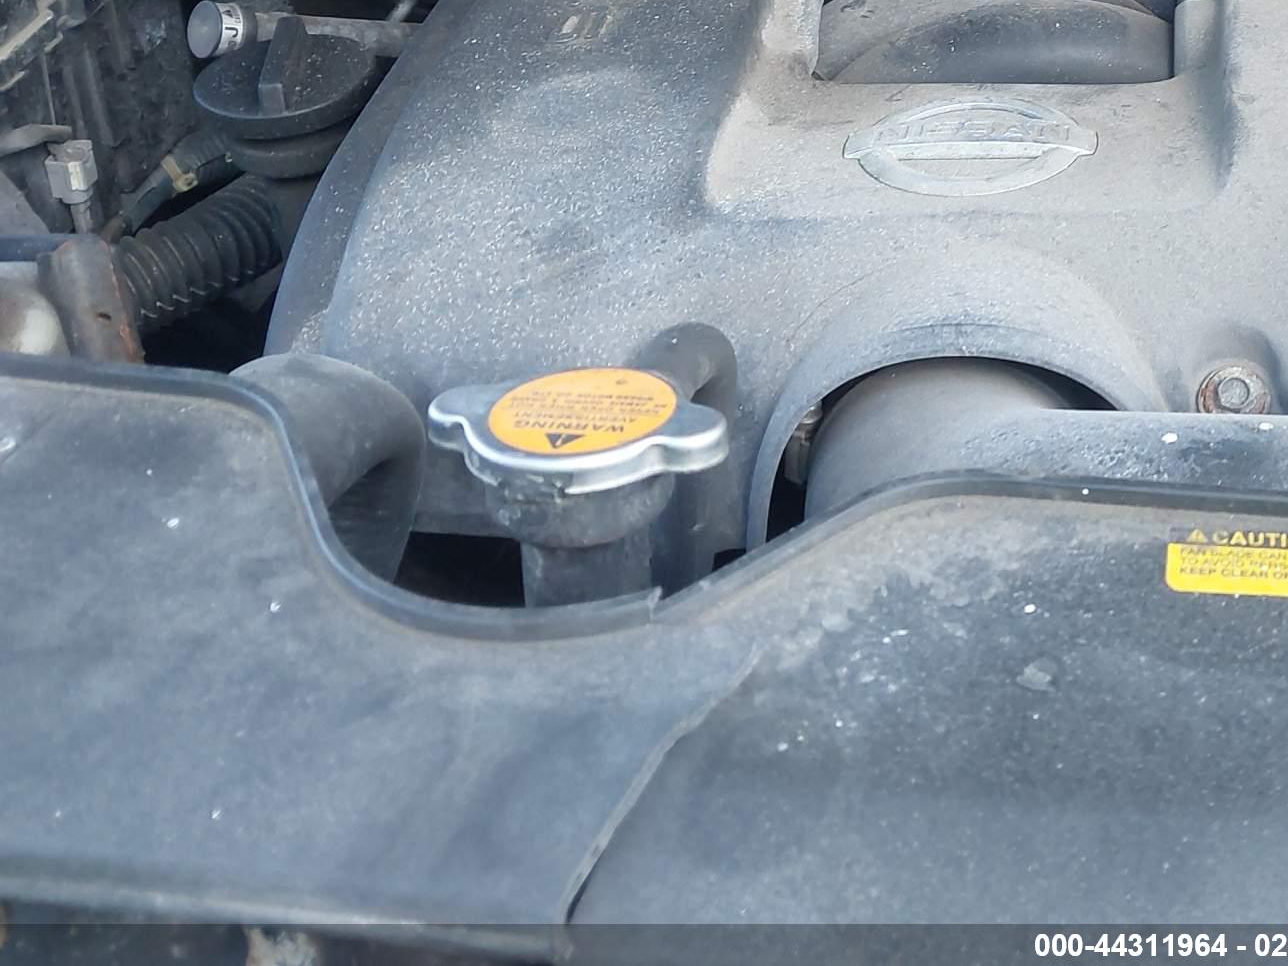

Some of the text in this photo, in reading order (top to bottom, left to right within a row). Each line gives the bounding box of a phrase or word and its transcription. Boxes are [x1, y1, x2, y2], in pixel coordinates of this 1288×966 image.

[514, 419, 624, 432] WARNING
[1179, 567, 1217, 576] KEEP
[1220, 569, 1269, 579] CLEAR
